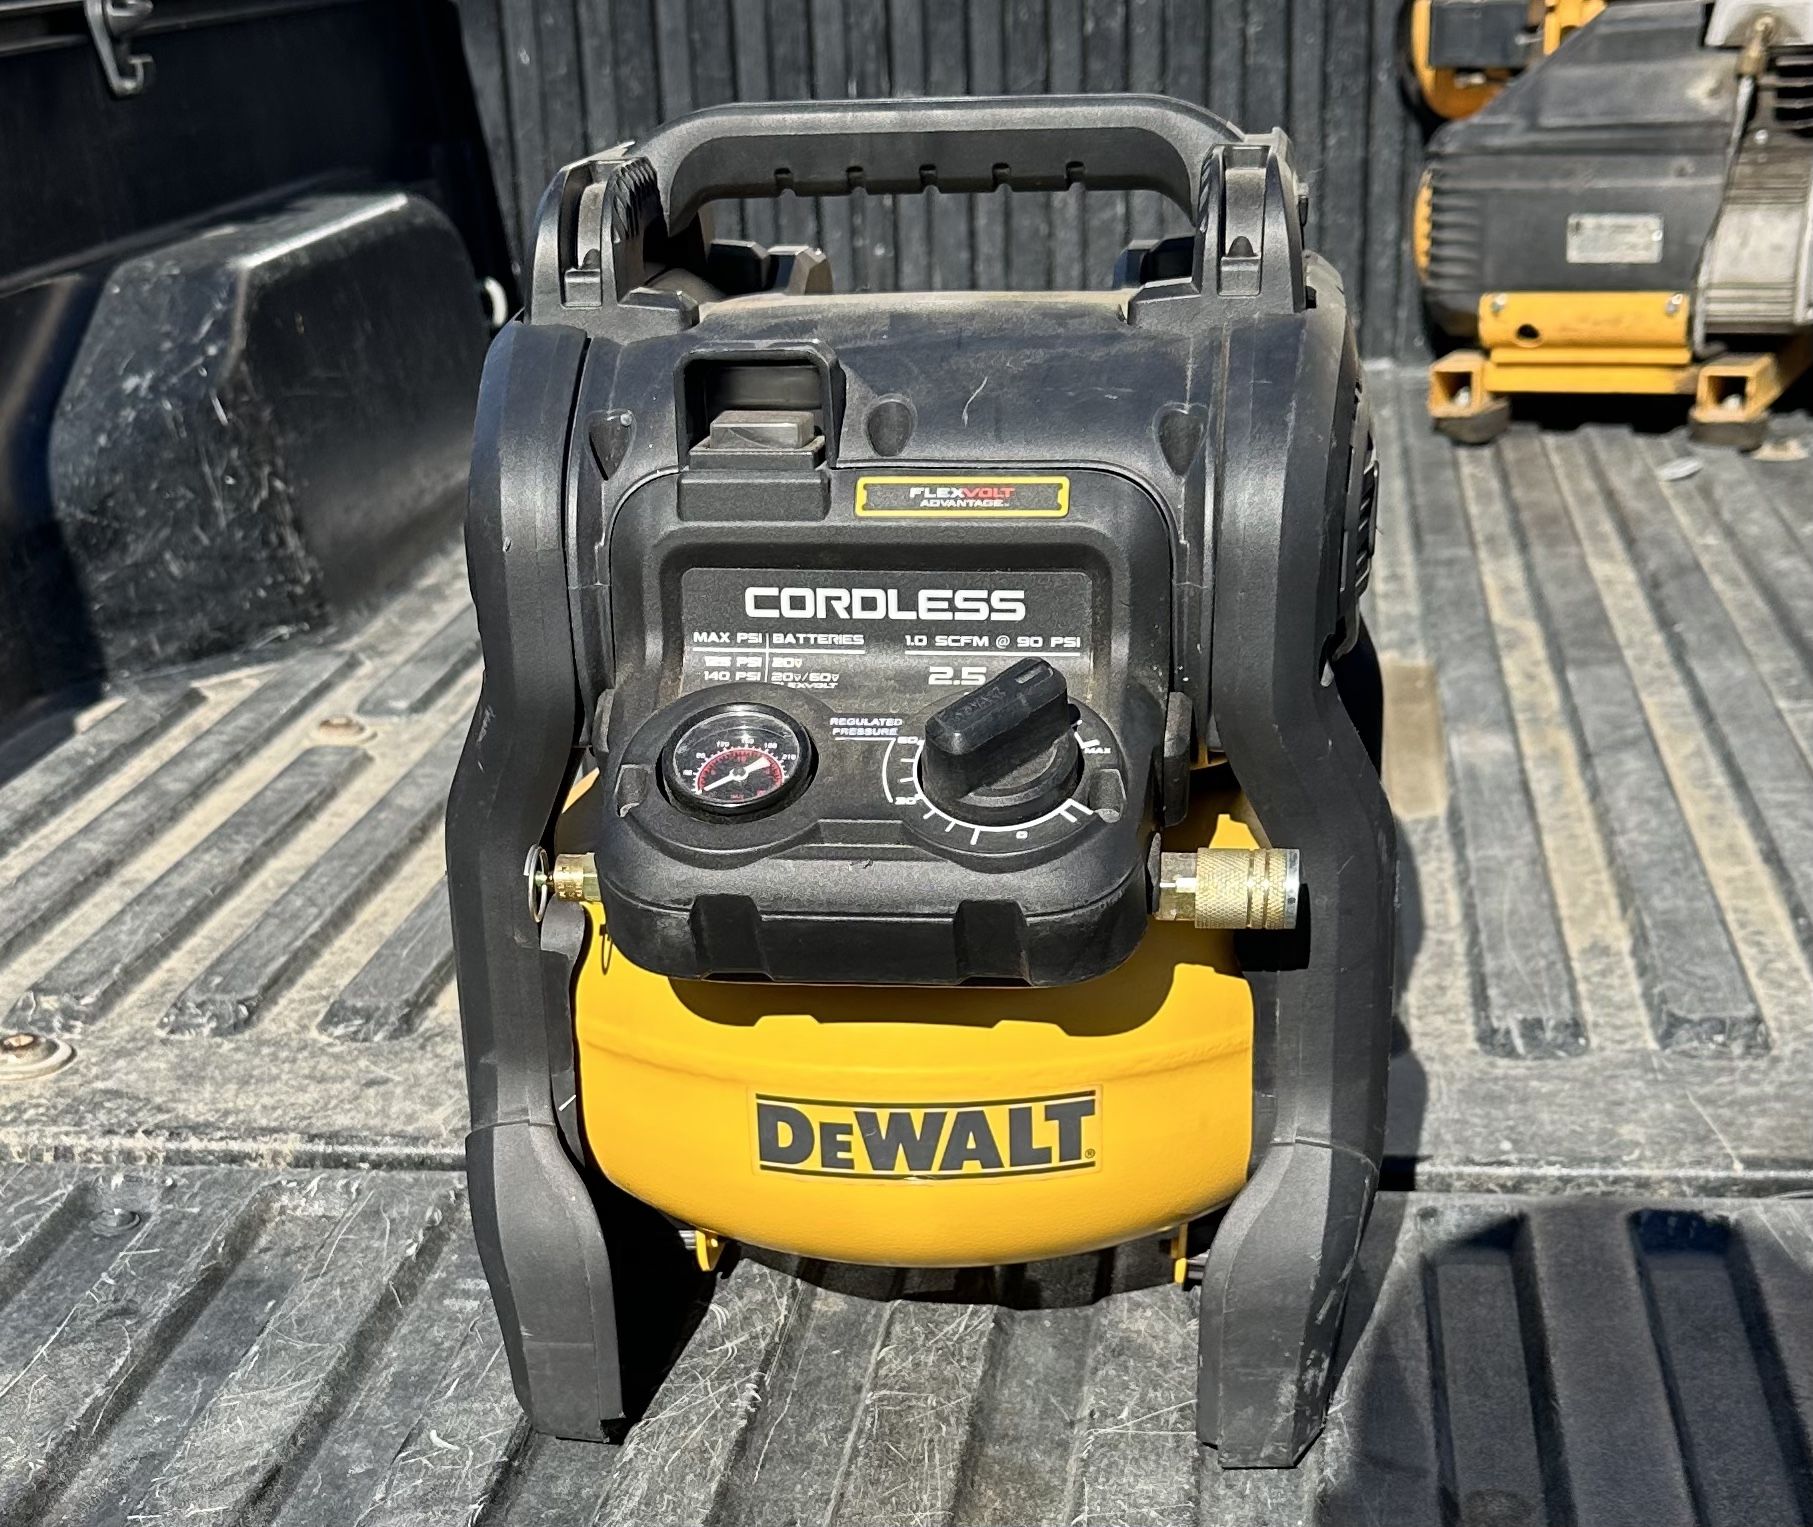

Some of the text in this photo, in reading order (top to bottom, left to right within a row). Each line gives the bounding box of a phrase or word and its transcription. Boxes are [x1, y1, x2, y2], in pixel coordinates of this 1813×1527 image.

[909, 487, 1016, 499] FLEXVOLT
[744, 587, 1027, 621] CORDLESS
[692, 631, 763, 644] MAX PSI
[772, 633, 865, 645] BATTERIES
[905, 634, 1081, 649] 1.0 SCFM @ 90 PSI
[736, 656, 763, 668] PSI
[703, 671, 762, 682] 140 PSI
[928, 666, 987, 686] 2.5
[829, 717, 903, 727] REGULATED
[832, 727, 899, 737] PRESSURE
